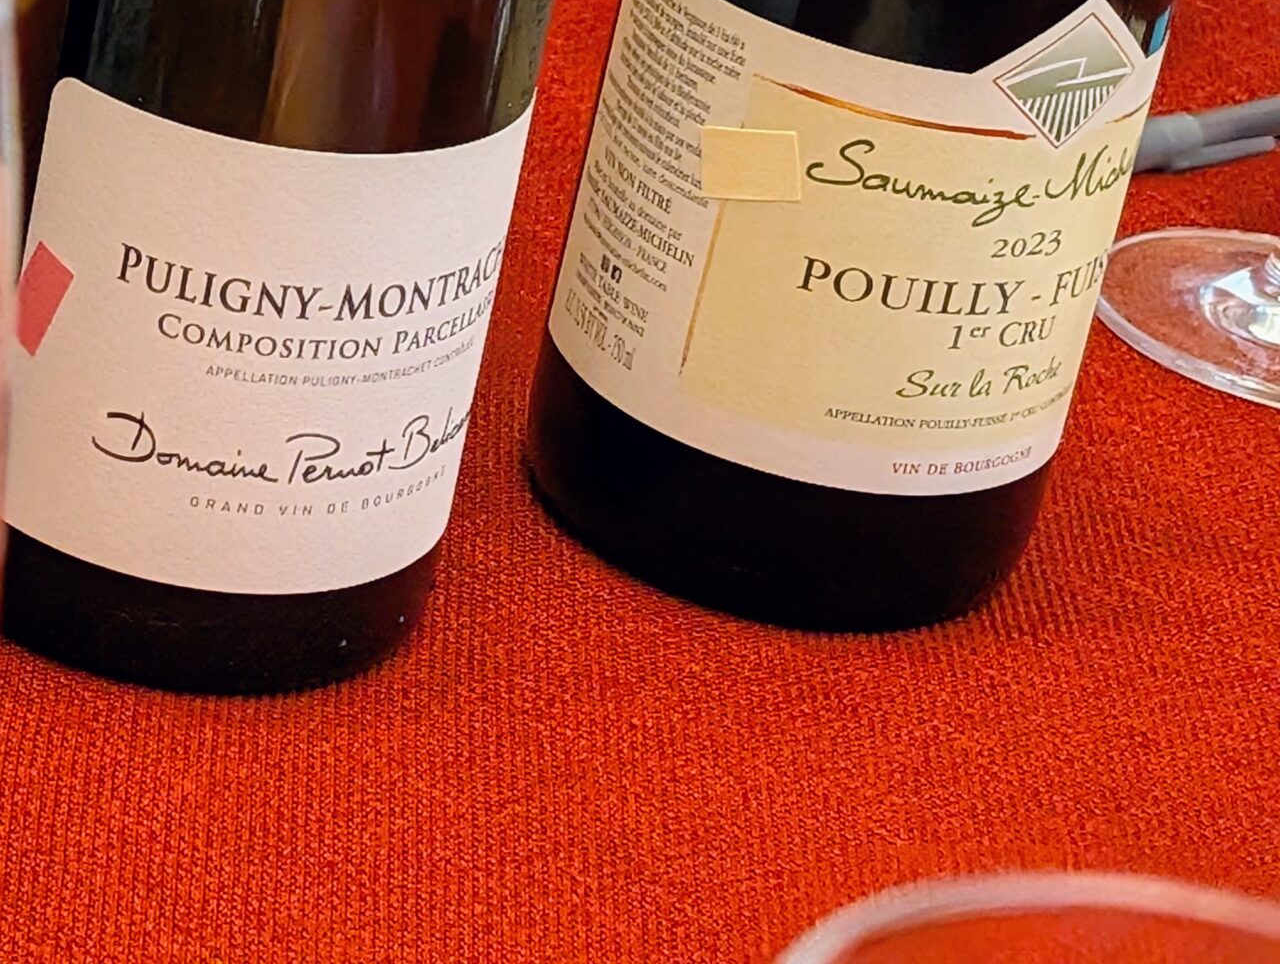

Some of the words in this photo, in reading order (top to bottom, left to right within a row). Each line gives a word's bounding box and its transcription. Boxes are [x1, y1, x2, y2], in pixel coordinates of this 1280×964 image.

[991, 229, 1062, 259] 2023
[796, 255, 1026, 316] POUILLY
[157, 313, 383, 361] COMPOSITION
[998, 315, 1058, 348] CRU
[205, 365, 298, 386] APPELLATION
[895, 369, 963, 399] Sur
[968, 368, 993, 399] la
[1002, 355, 1063, 394] Roche
[824, 407, 916, 429] APPELLATION
[92, 411, 279, 484] Domaine
[285, 432, 396, 485] Pernot
[892, 462, 922, 476] VIN
[927, 461, 947, 476] DE
[954, 445, 1033, 475] BOURGOGNE
[189, 494, 265, 516] GRAND
[279, 502, 314, 517] VIN
[326, 499, 350, 516] DE
